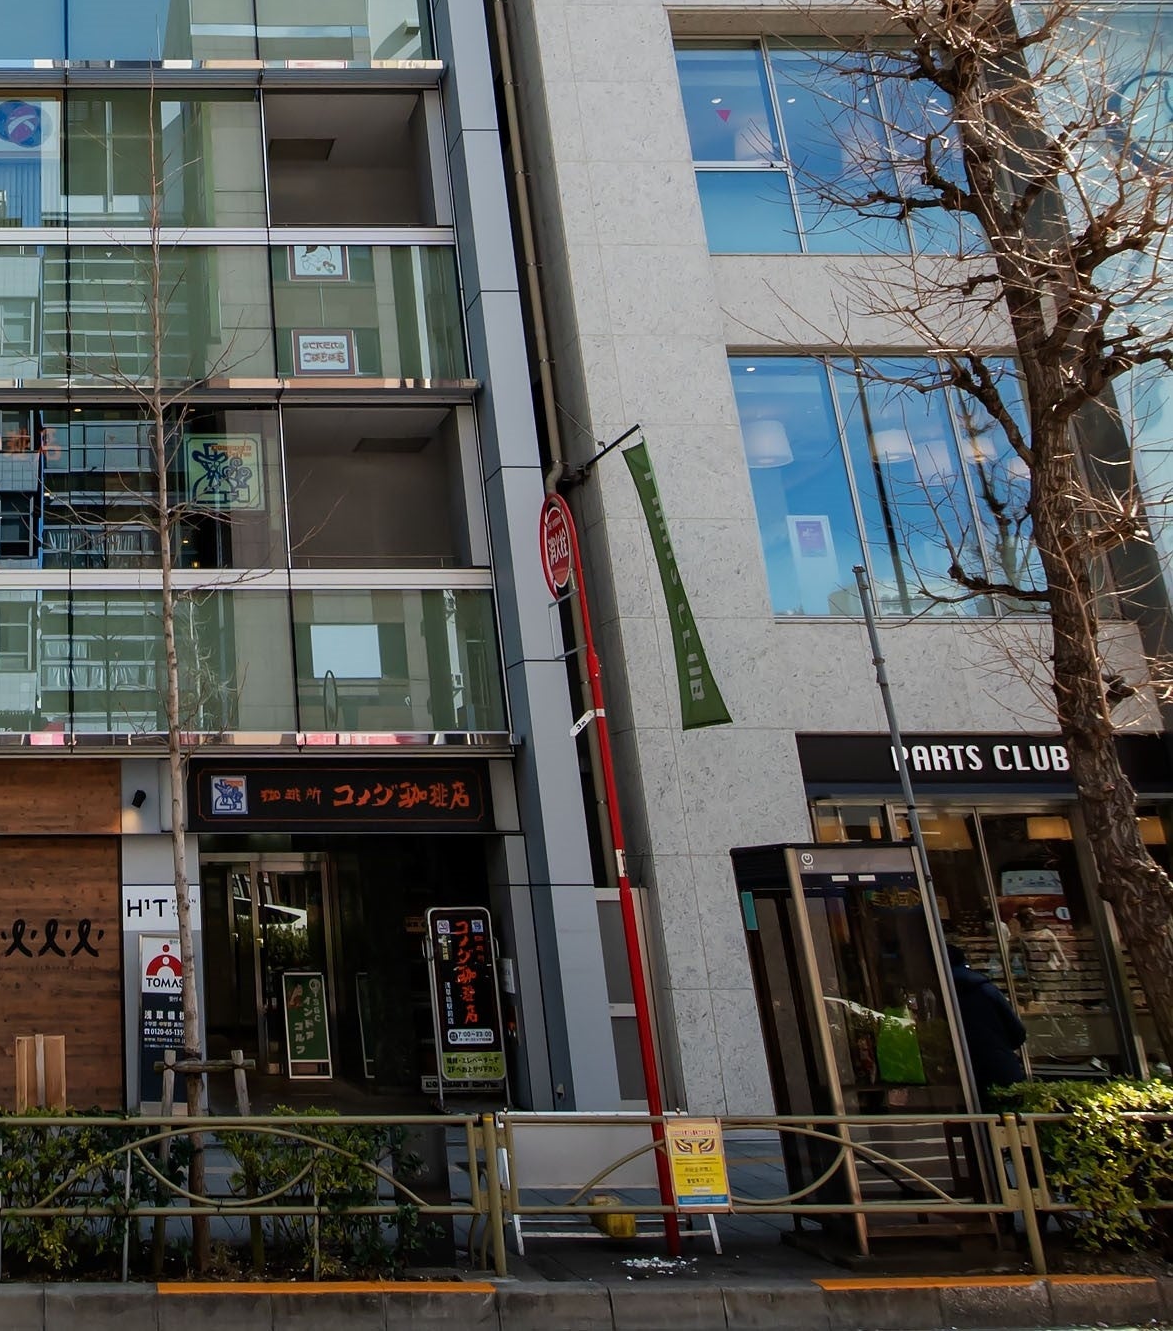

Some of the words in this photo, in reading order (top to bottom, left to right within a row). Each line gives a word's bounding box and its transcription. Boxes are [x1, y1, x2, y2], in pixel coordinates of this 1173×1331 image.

[548, 527, 569, 567] 消火栓
[993, 744, 1071, 772] CLUB
[333, 780, 470, 810] コメダ珈琲店
